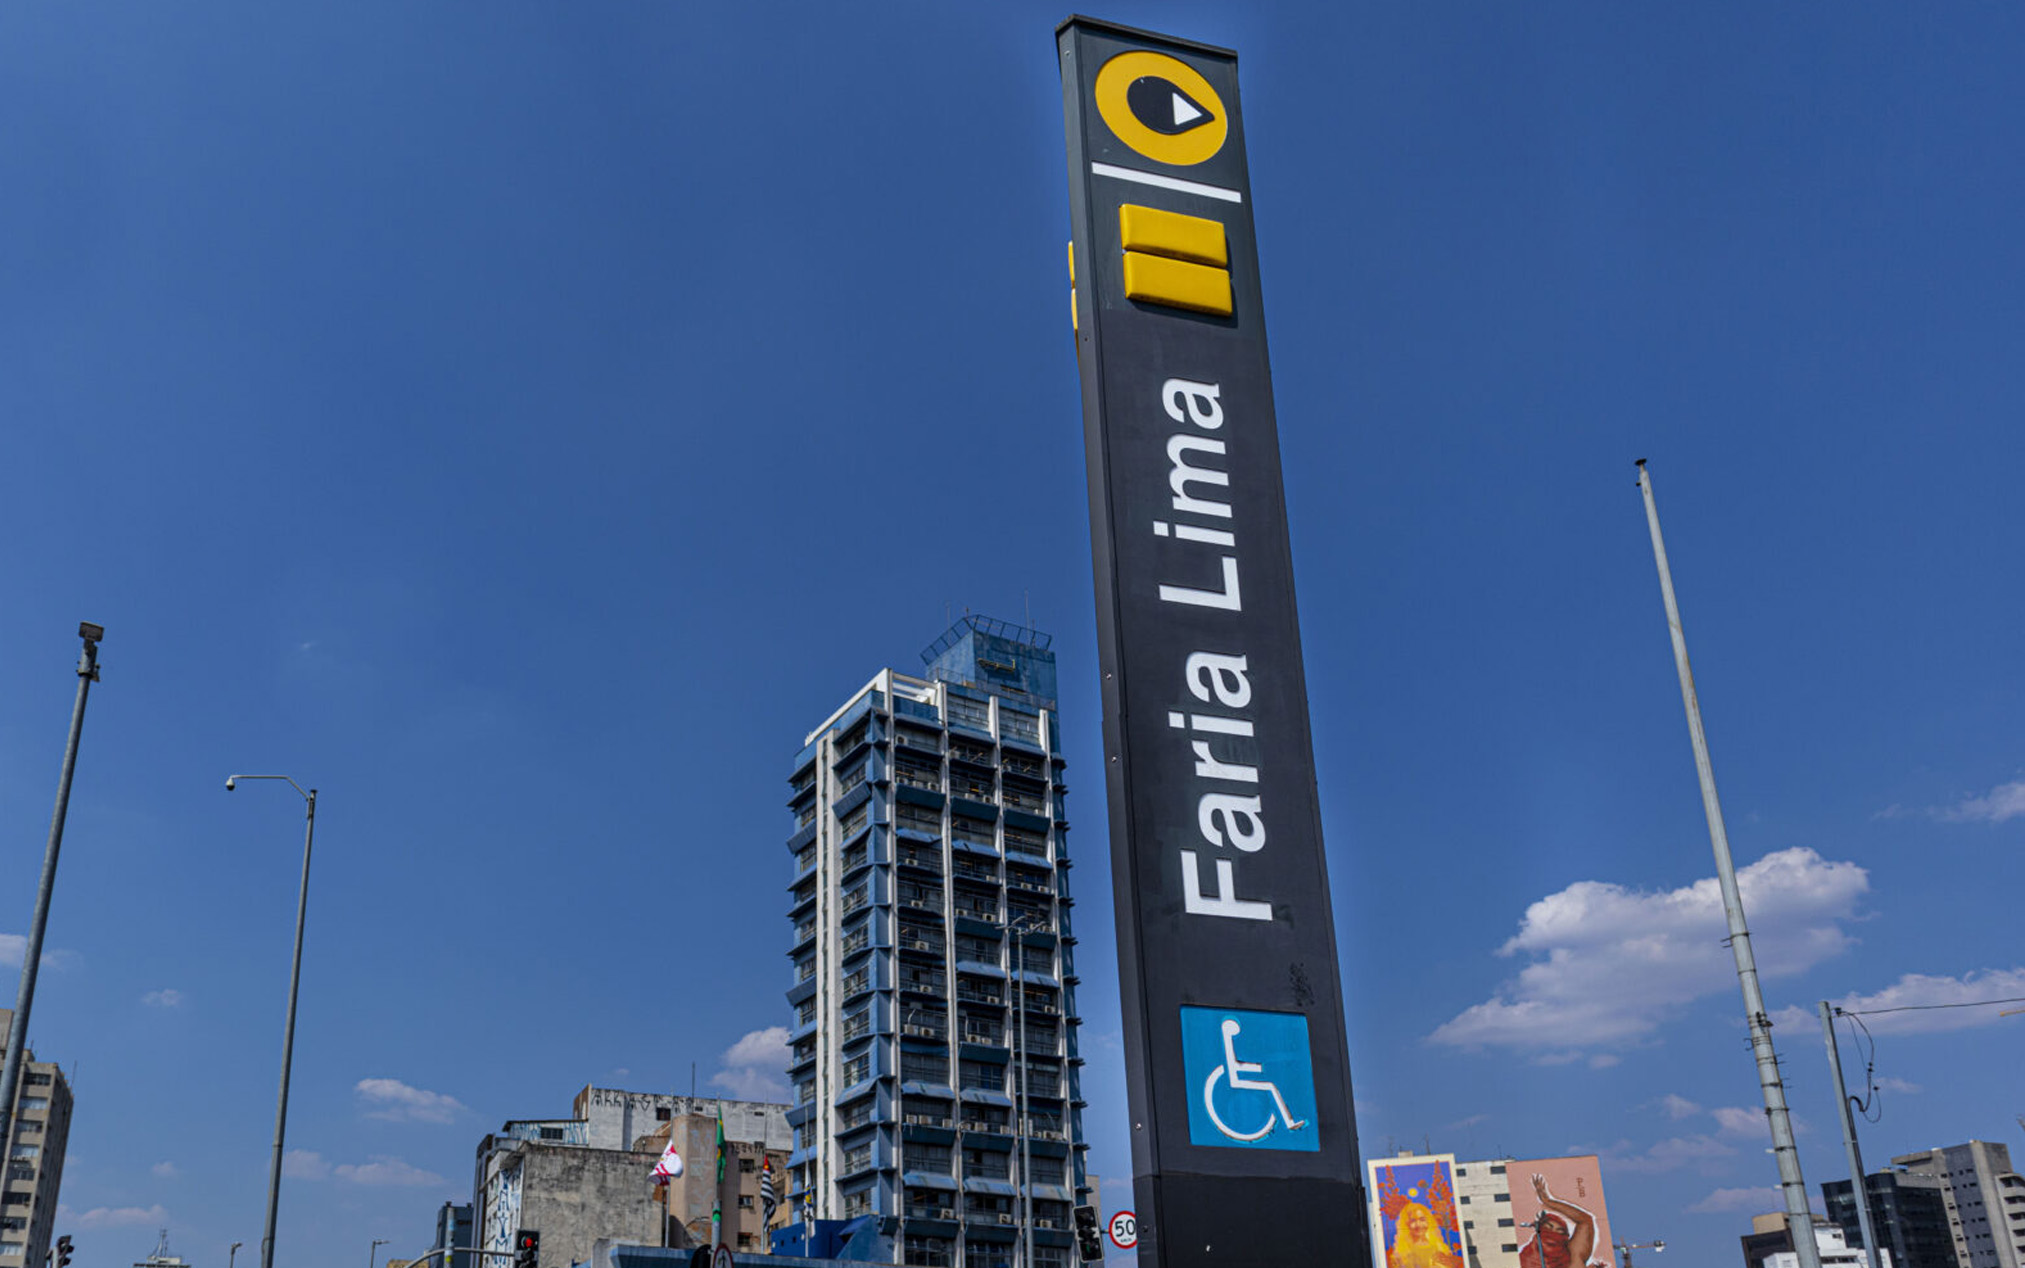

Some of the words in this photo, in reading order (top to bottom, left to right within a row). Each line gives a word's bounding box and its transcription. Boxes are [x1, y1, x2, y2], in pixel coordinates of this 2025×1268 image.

[1153, 377, 1242, 612] Lima
[1168, 651, 1273, 921] Faria
[1115, 1219, 1135, 1237] 50
